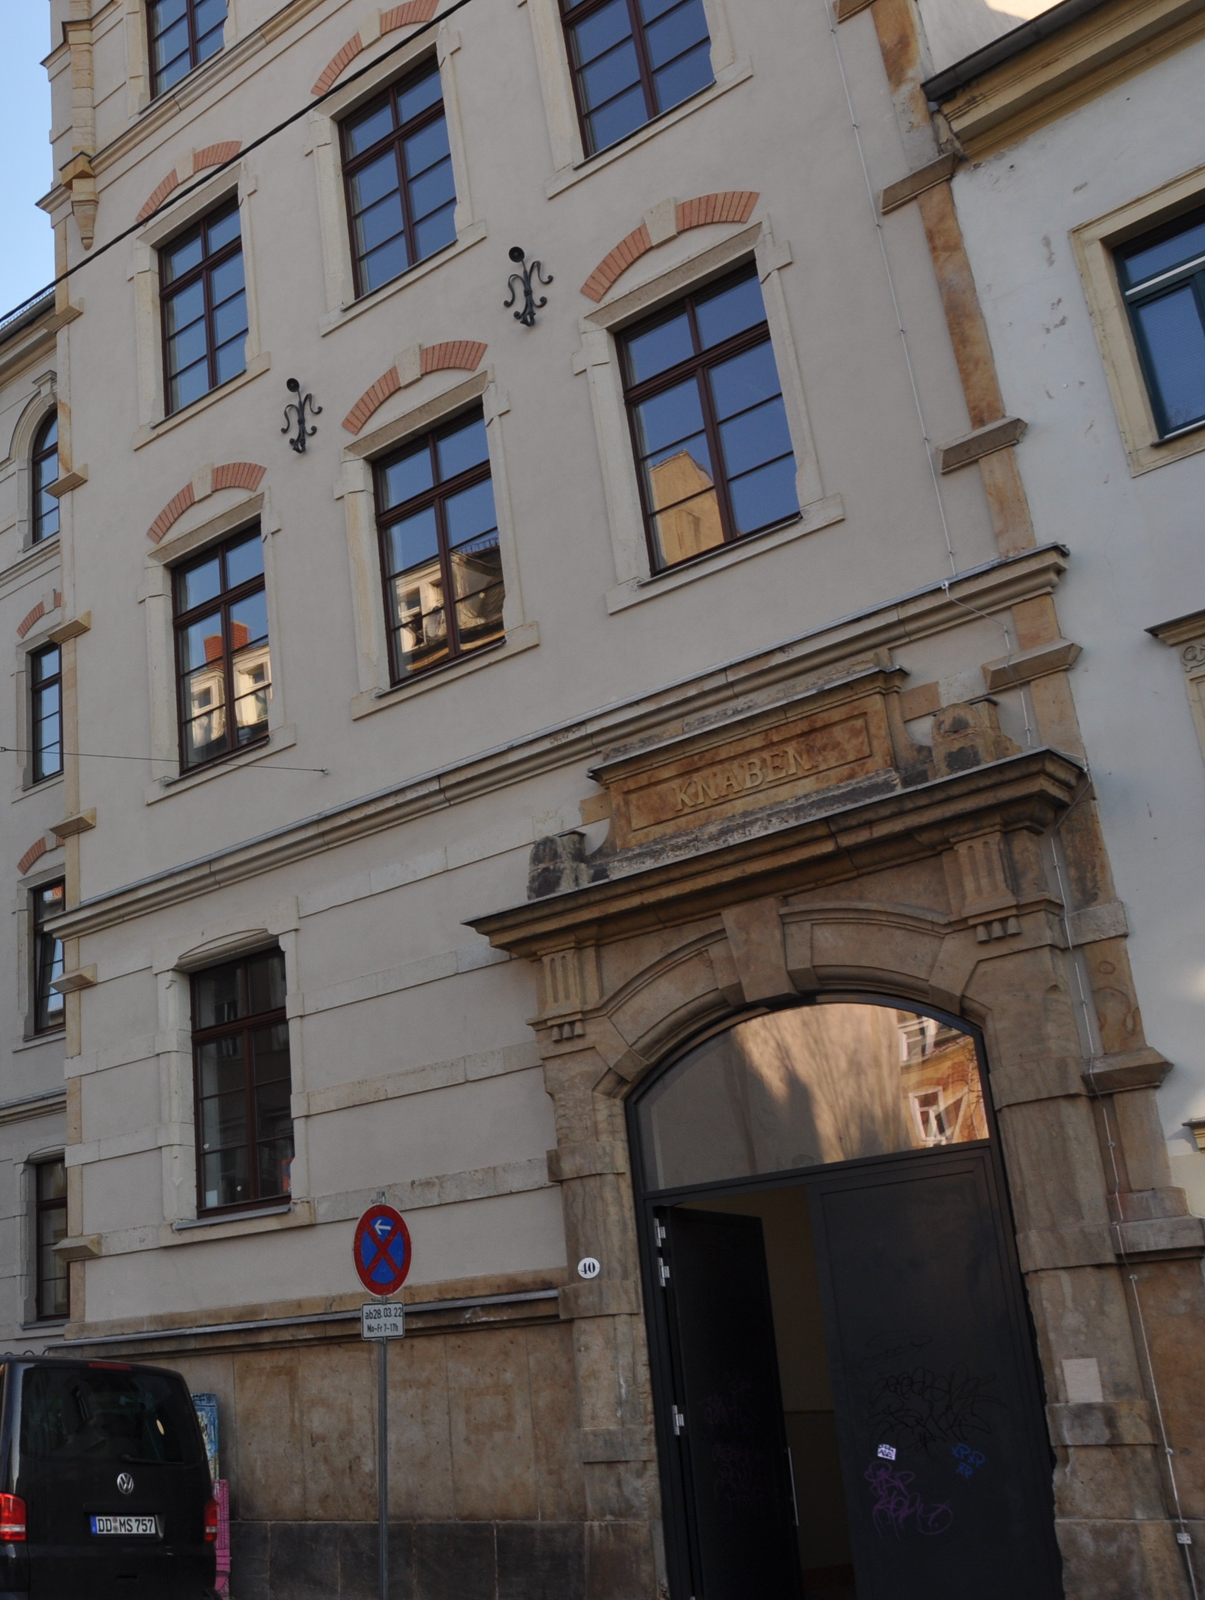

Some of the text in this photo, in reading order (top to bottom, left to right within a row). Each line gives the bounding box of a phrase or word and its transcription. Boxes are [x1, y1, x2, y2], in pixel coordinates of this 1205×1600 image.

[672, 743, 815, 812] KNABEN
[580, 1261, 596, 1275] 40
[97, 1518, 154, 1533] DD MS 757
